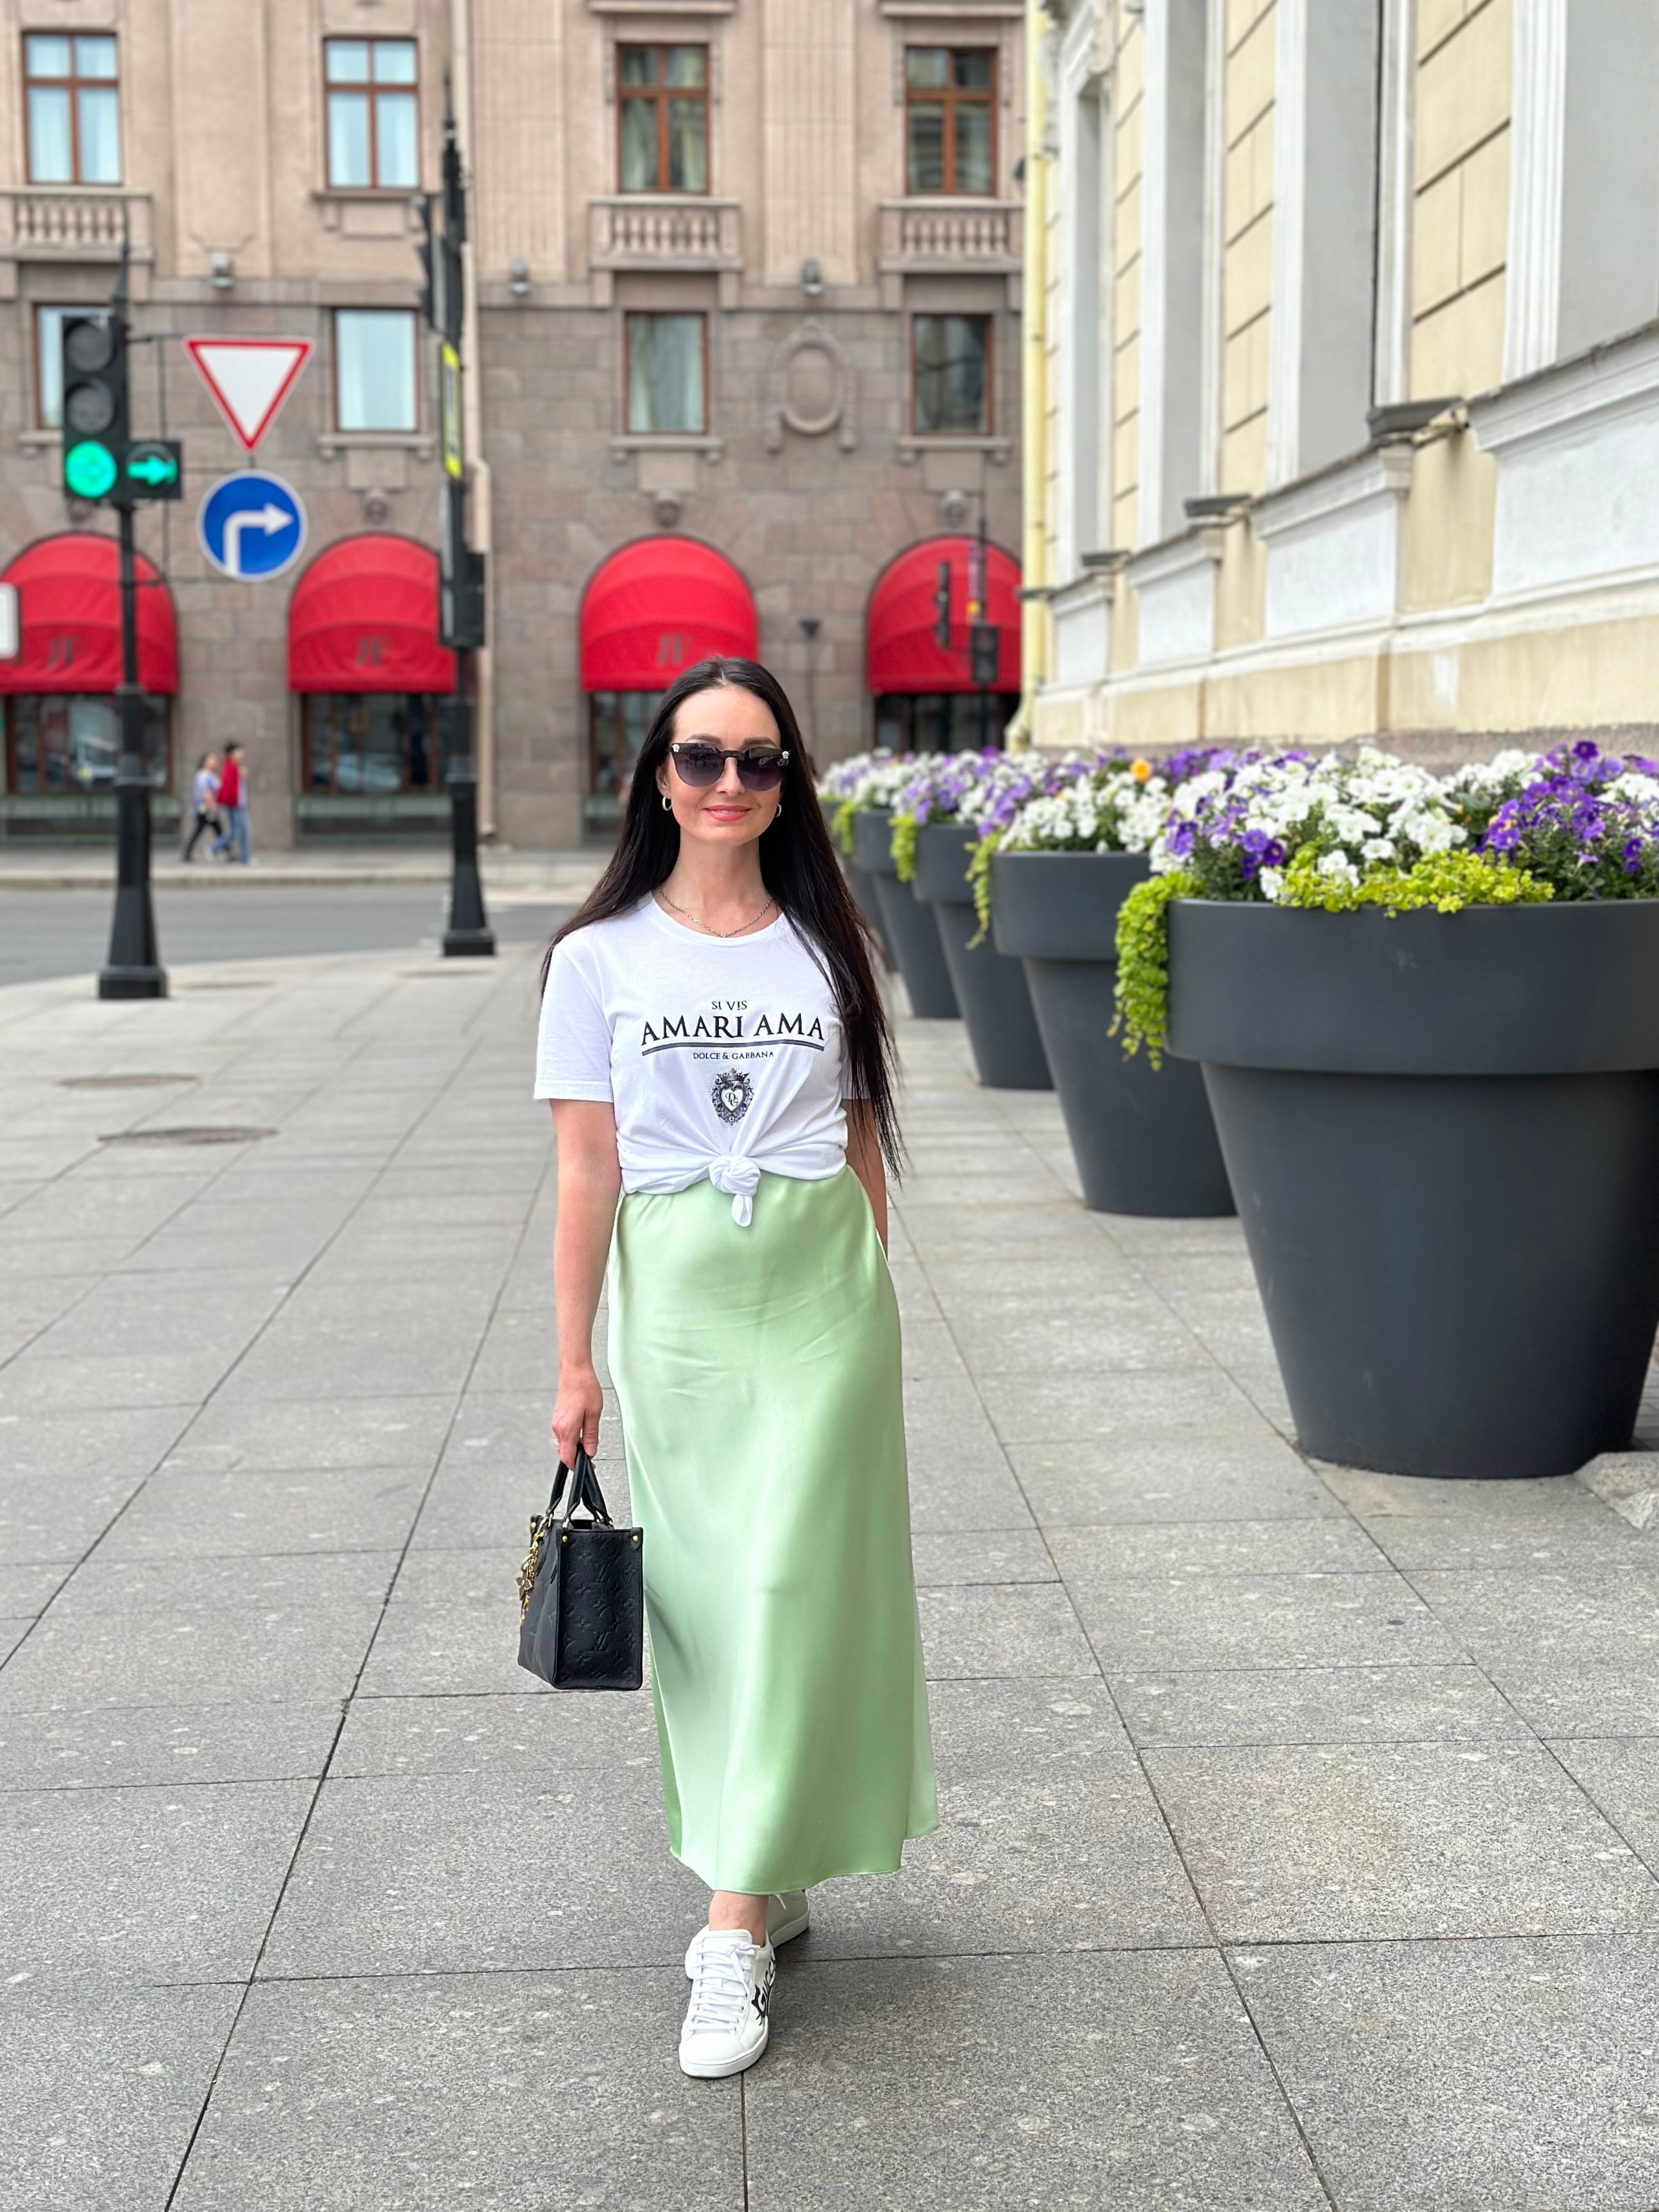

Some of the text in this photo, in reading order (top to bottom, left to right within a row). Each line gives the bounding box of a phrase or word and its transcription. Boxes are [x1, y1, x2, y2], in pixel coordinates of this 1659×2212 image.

[712, 1000, 747, 1010] SI VIS
[641, 1013, 824, 1045] AMARI AMA
[732, 1050, 774, 1060] GABBANA
